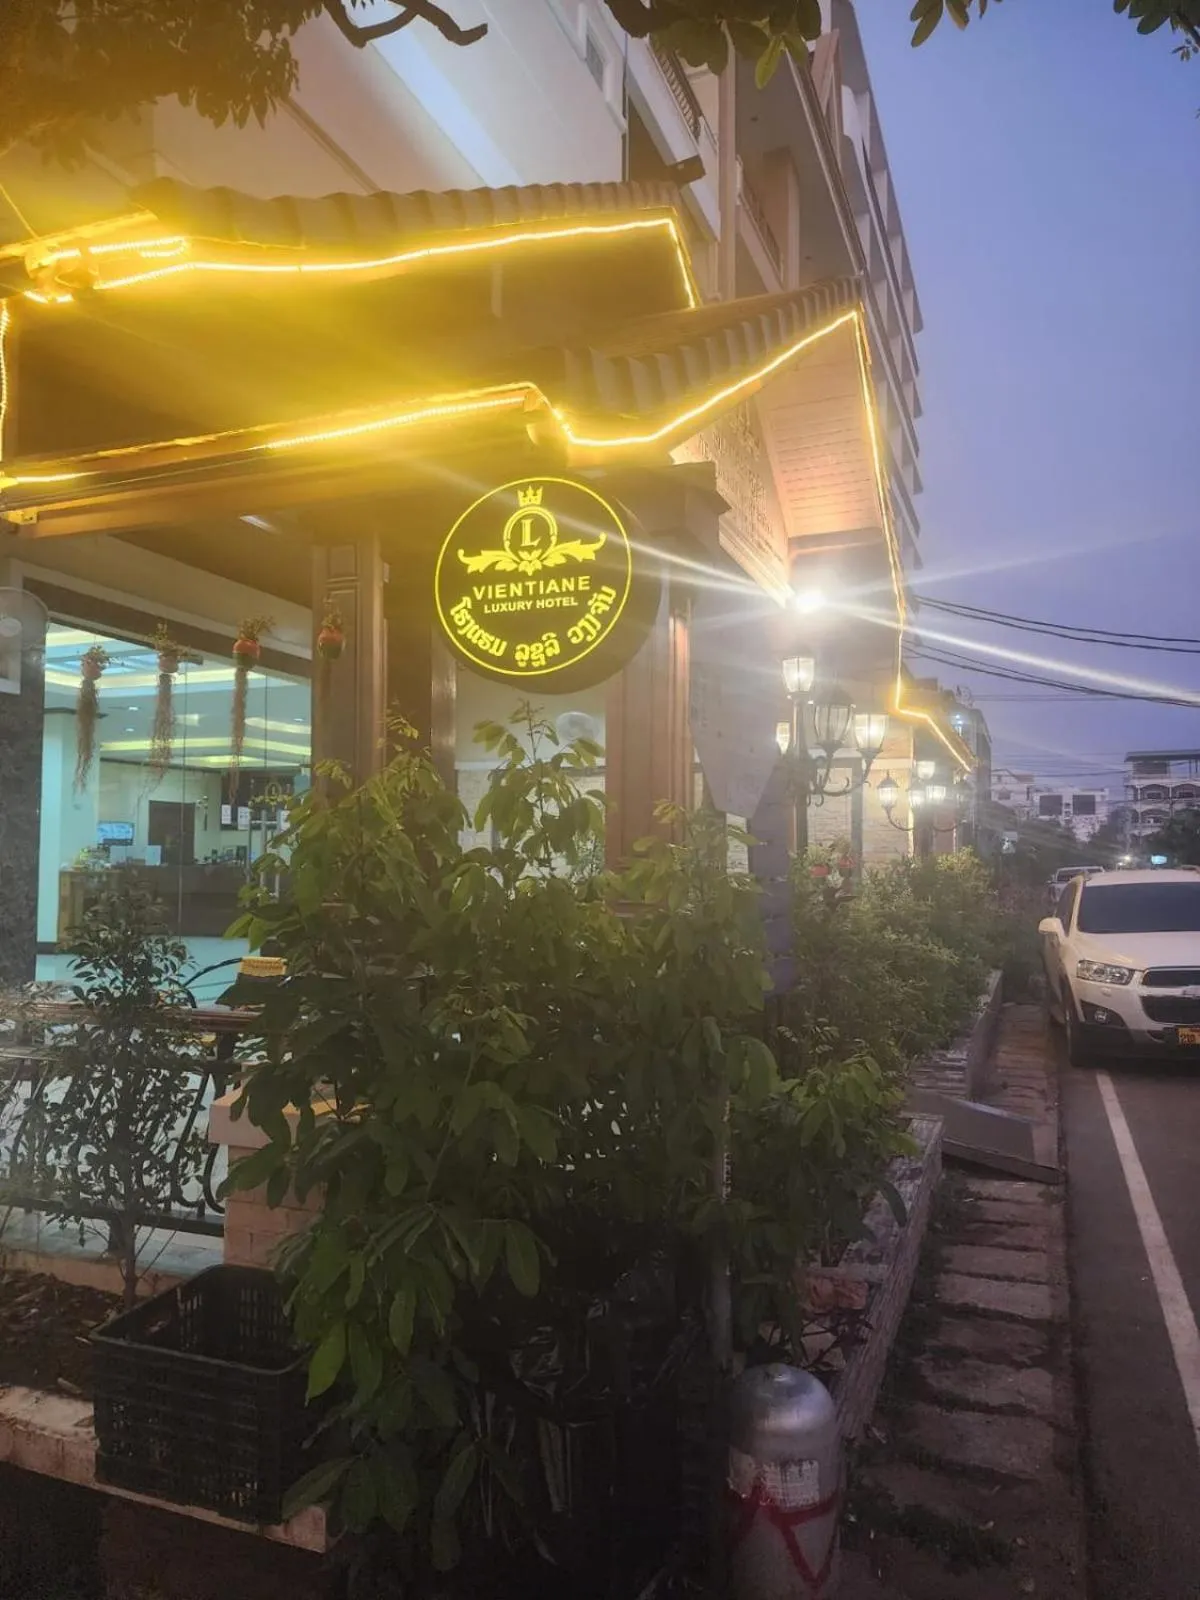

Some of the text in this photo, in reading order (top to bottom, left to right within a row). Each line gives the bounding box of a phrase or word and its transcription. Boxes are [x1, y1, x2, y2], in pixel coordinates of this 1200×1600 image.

[520, 518, 541, 547] L
[472, 575, 591, 601] VIENTIANE
[483, 596, 579, 614] LUXURY HOTEL
[450, 596, 507, 657] ໂຮງແຮມ
[567, 585, 617, 644] ວຽງຈັນ
